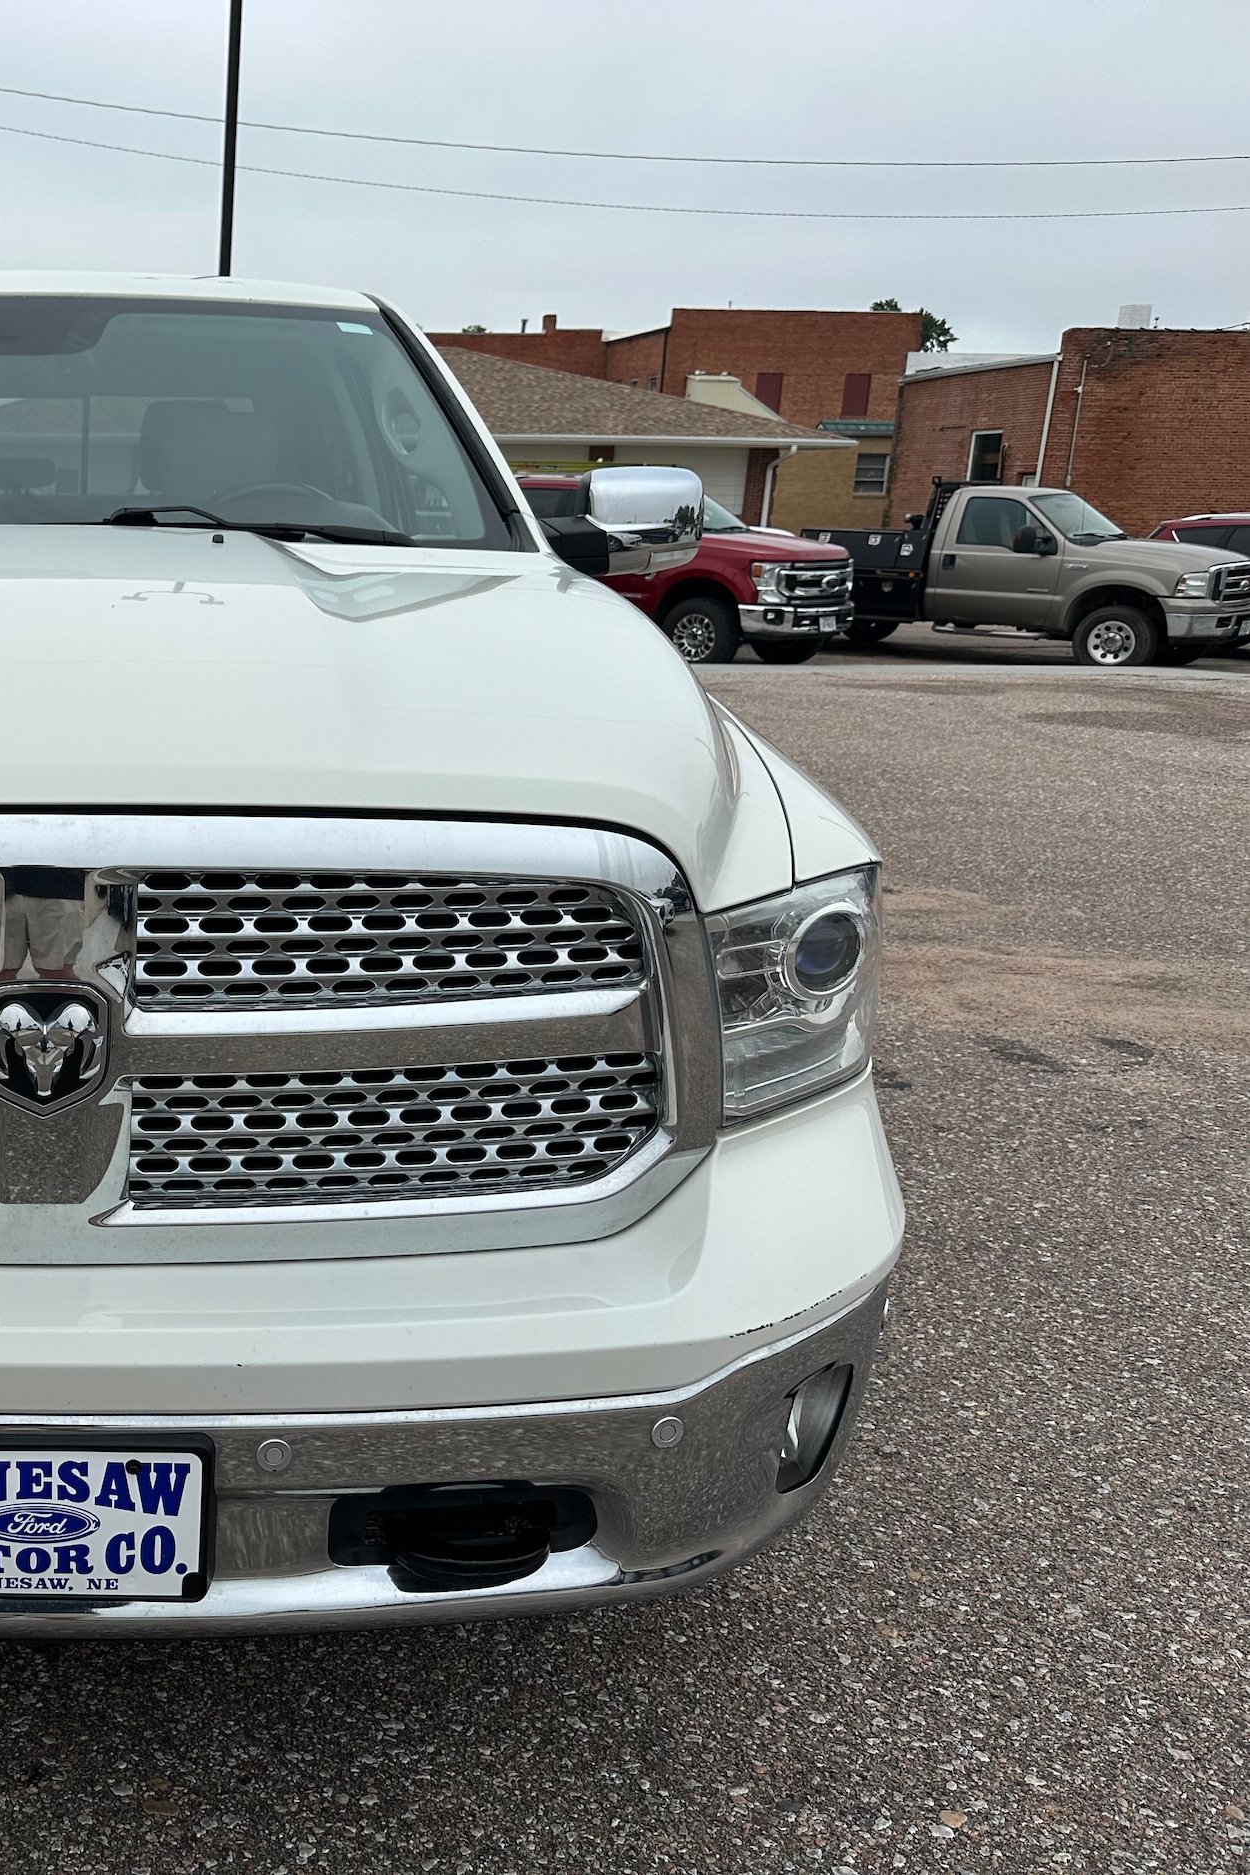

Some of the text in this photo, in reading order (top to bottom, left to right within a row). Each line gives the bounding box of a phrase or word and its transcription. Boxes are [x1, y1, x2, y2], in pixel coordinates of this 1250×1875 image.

[7, 1512, 68, 1535] Ford
[104, 1525, 188, 1575] CO.
[86, 1577, 119, 1591] NE
